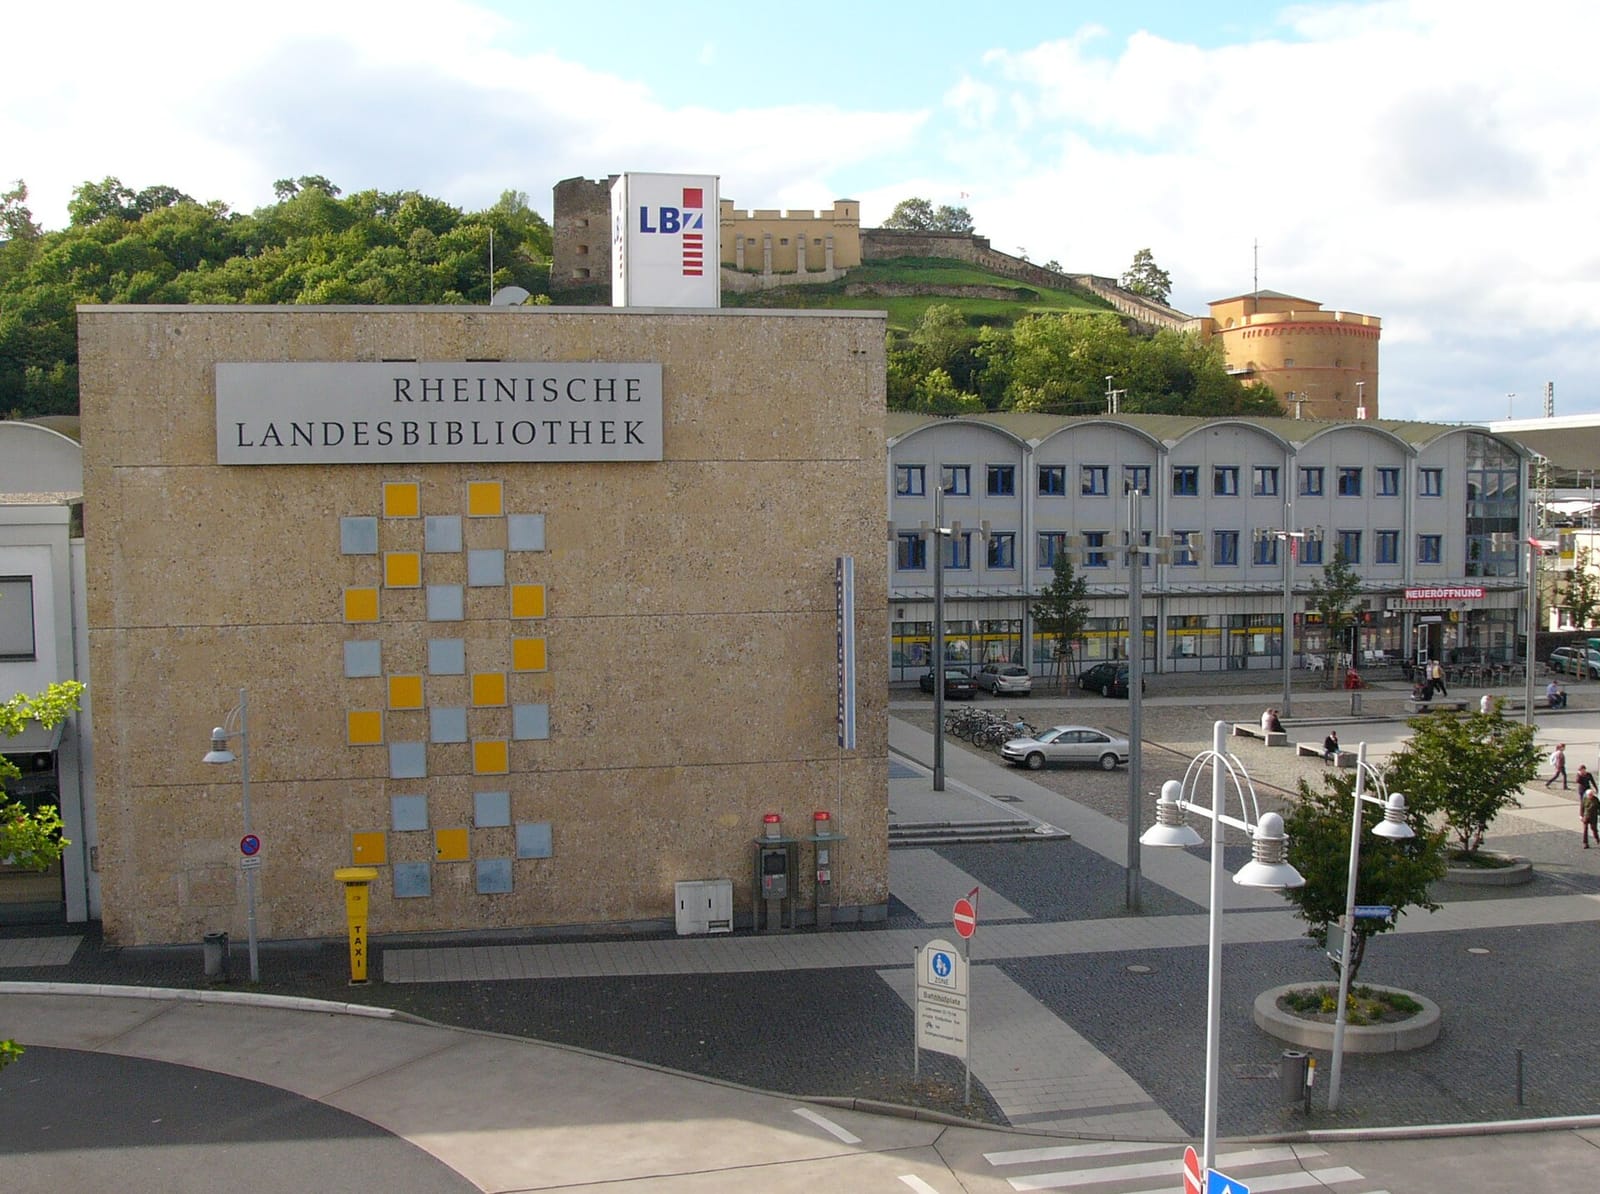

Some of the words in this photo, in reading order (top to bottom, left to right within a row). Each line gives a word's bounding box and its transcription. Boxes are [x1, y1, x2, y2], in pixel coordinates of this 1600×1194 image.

[640, 206, 703, 234] LBZ
[392, 377, 642, 403] RHEINISCHE
[236, 420, 646, 447] LANDESBIBLIOTHEK
[1406, 588, 1482, 599] NEUERÖFFNUNG
[354, 926, 362, 968] TAXI
